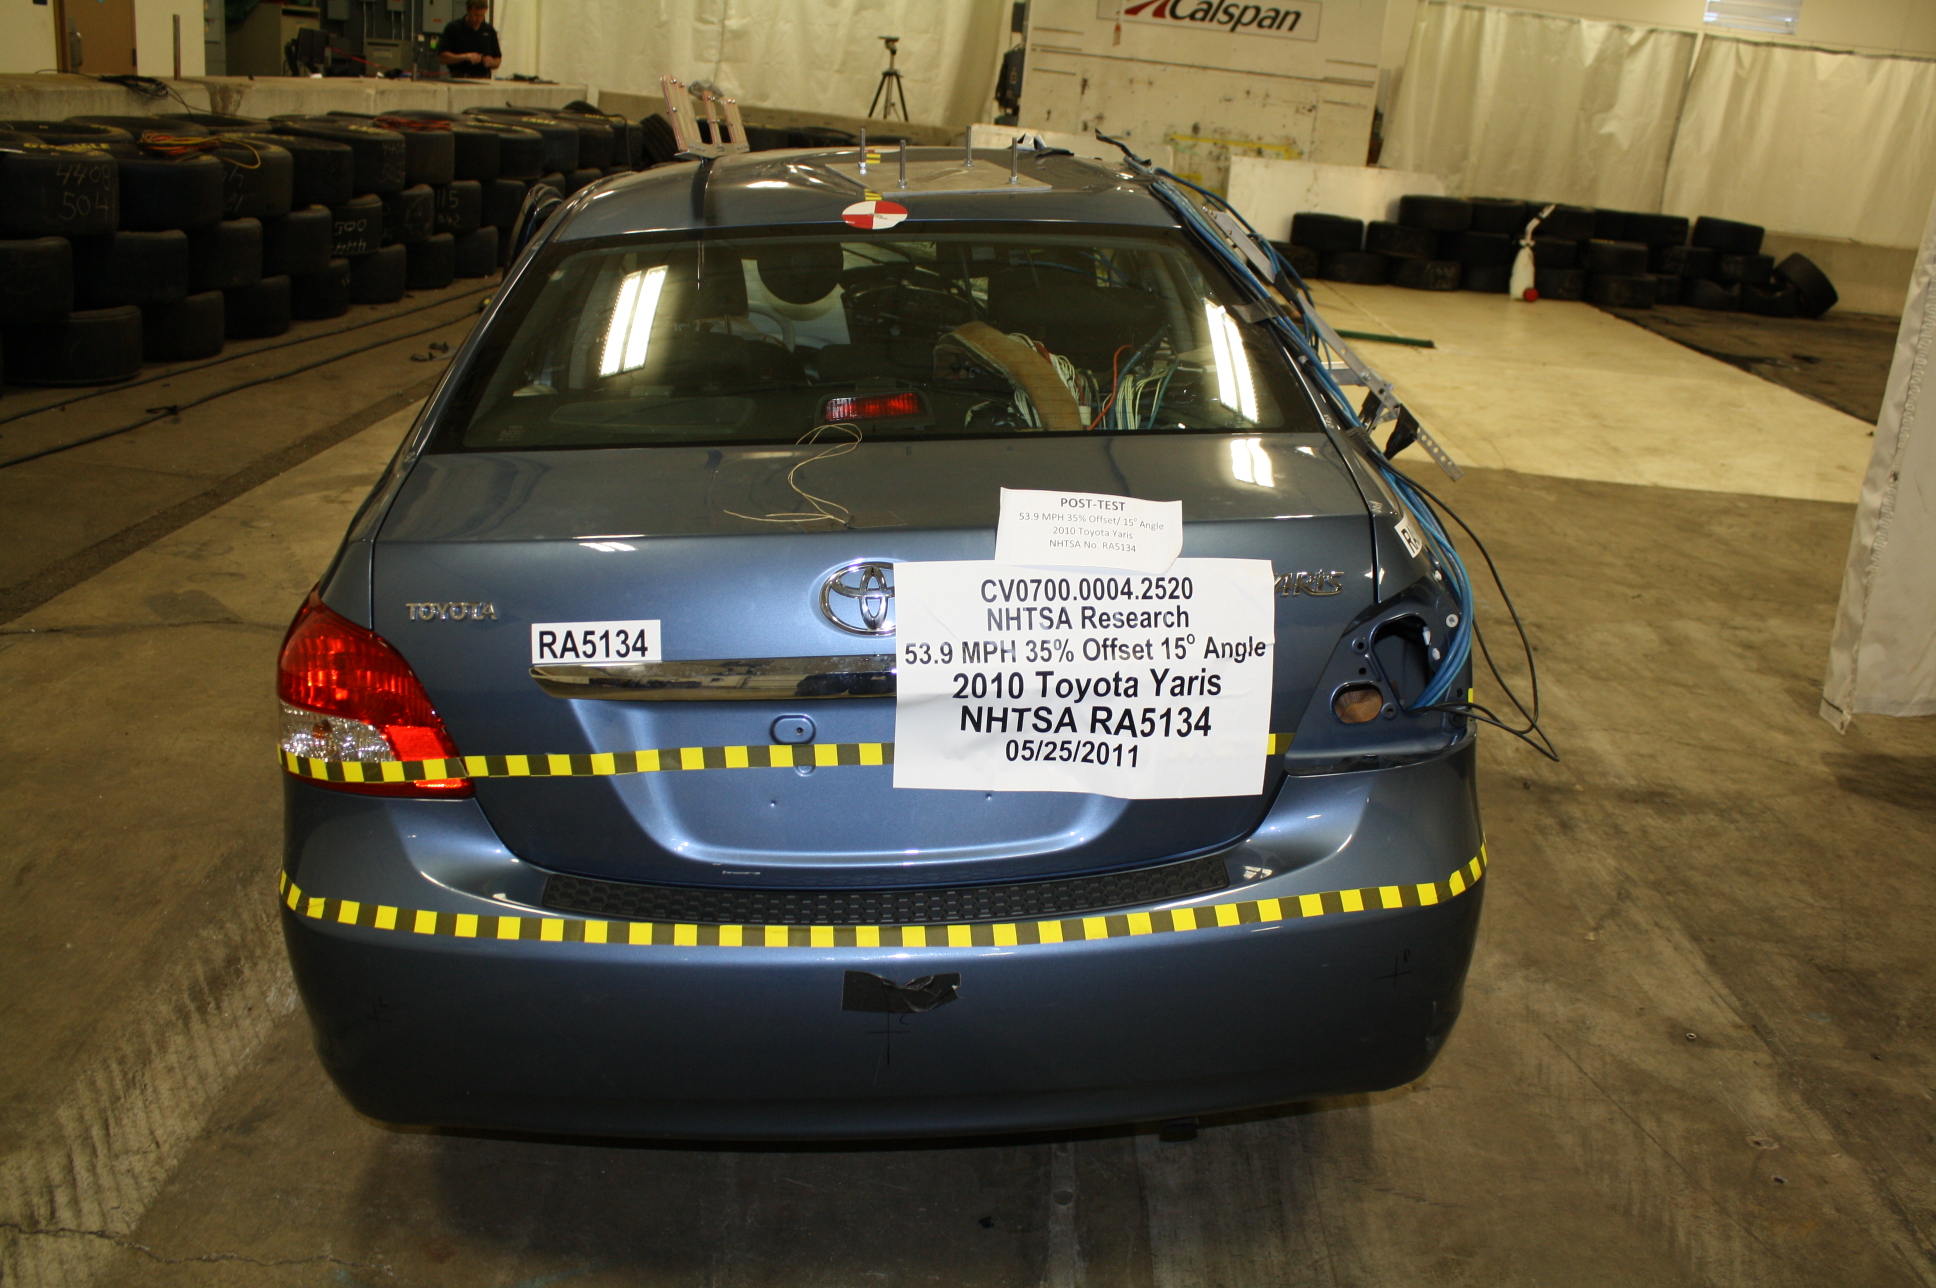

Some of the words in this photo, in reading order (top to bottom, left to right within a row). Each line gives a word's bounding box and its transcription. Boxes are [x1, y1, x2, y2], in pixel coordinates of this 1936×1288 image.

[1169, 0, 1301, 32] Calspan
[1060, 497, 1126, 512] POST-TEST
[1019, 512, 1039, 521] 53.9
[1042, 513, 1064, 522] MPH
[1067, 513, 1086, 522] 35%
[1088, 514, 1121, 525] Offset/
[1139, 520, 1165, 532] Angle
[1052, 526, 1076, 535] 2010
[1078, 527, 1110, 538] Toyota
[1112, 529, 1134, 540] Yaris
[1049, 539, 1081, 549] NHTSA
[1084, 540, 1099, 549] No.
[1102, 541, 1137, 553] RA5134
[981, 576, 1193, 603] CV0700.0004.2520
[406, 602, 498, 621] TOYOTA
[987, 607, 1073, 632] NHTSA
[1080, 605, 1190, 630] Research
[538, 628, 648, 660] RA5134
[905, 641, 953, 665] 53.9
[962, 639, 1017, 664] MPH
[1025, 638, 1074, 663] 35%
[1083, 637, 1153, 662] Offset
[1203, 635, 1267, 663] Angle
[952, 671, 1024, 700] 2010
[1035, 670, 1139, 704] Toyota
[1149, 667, 1222, 697] Yaris
[960, 705, 1077, 734] NHTSA
[1090, 705, 1212, 738] RA5134
[1005, 739, 1139, 768] 05/25/2011
